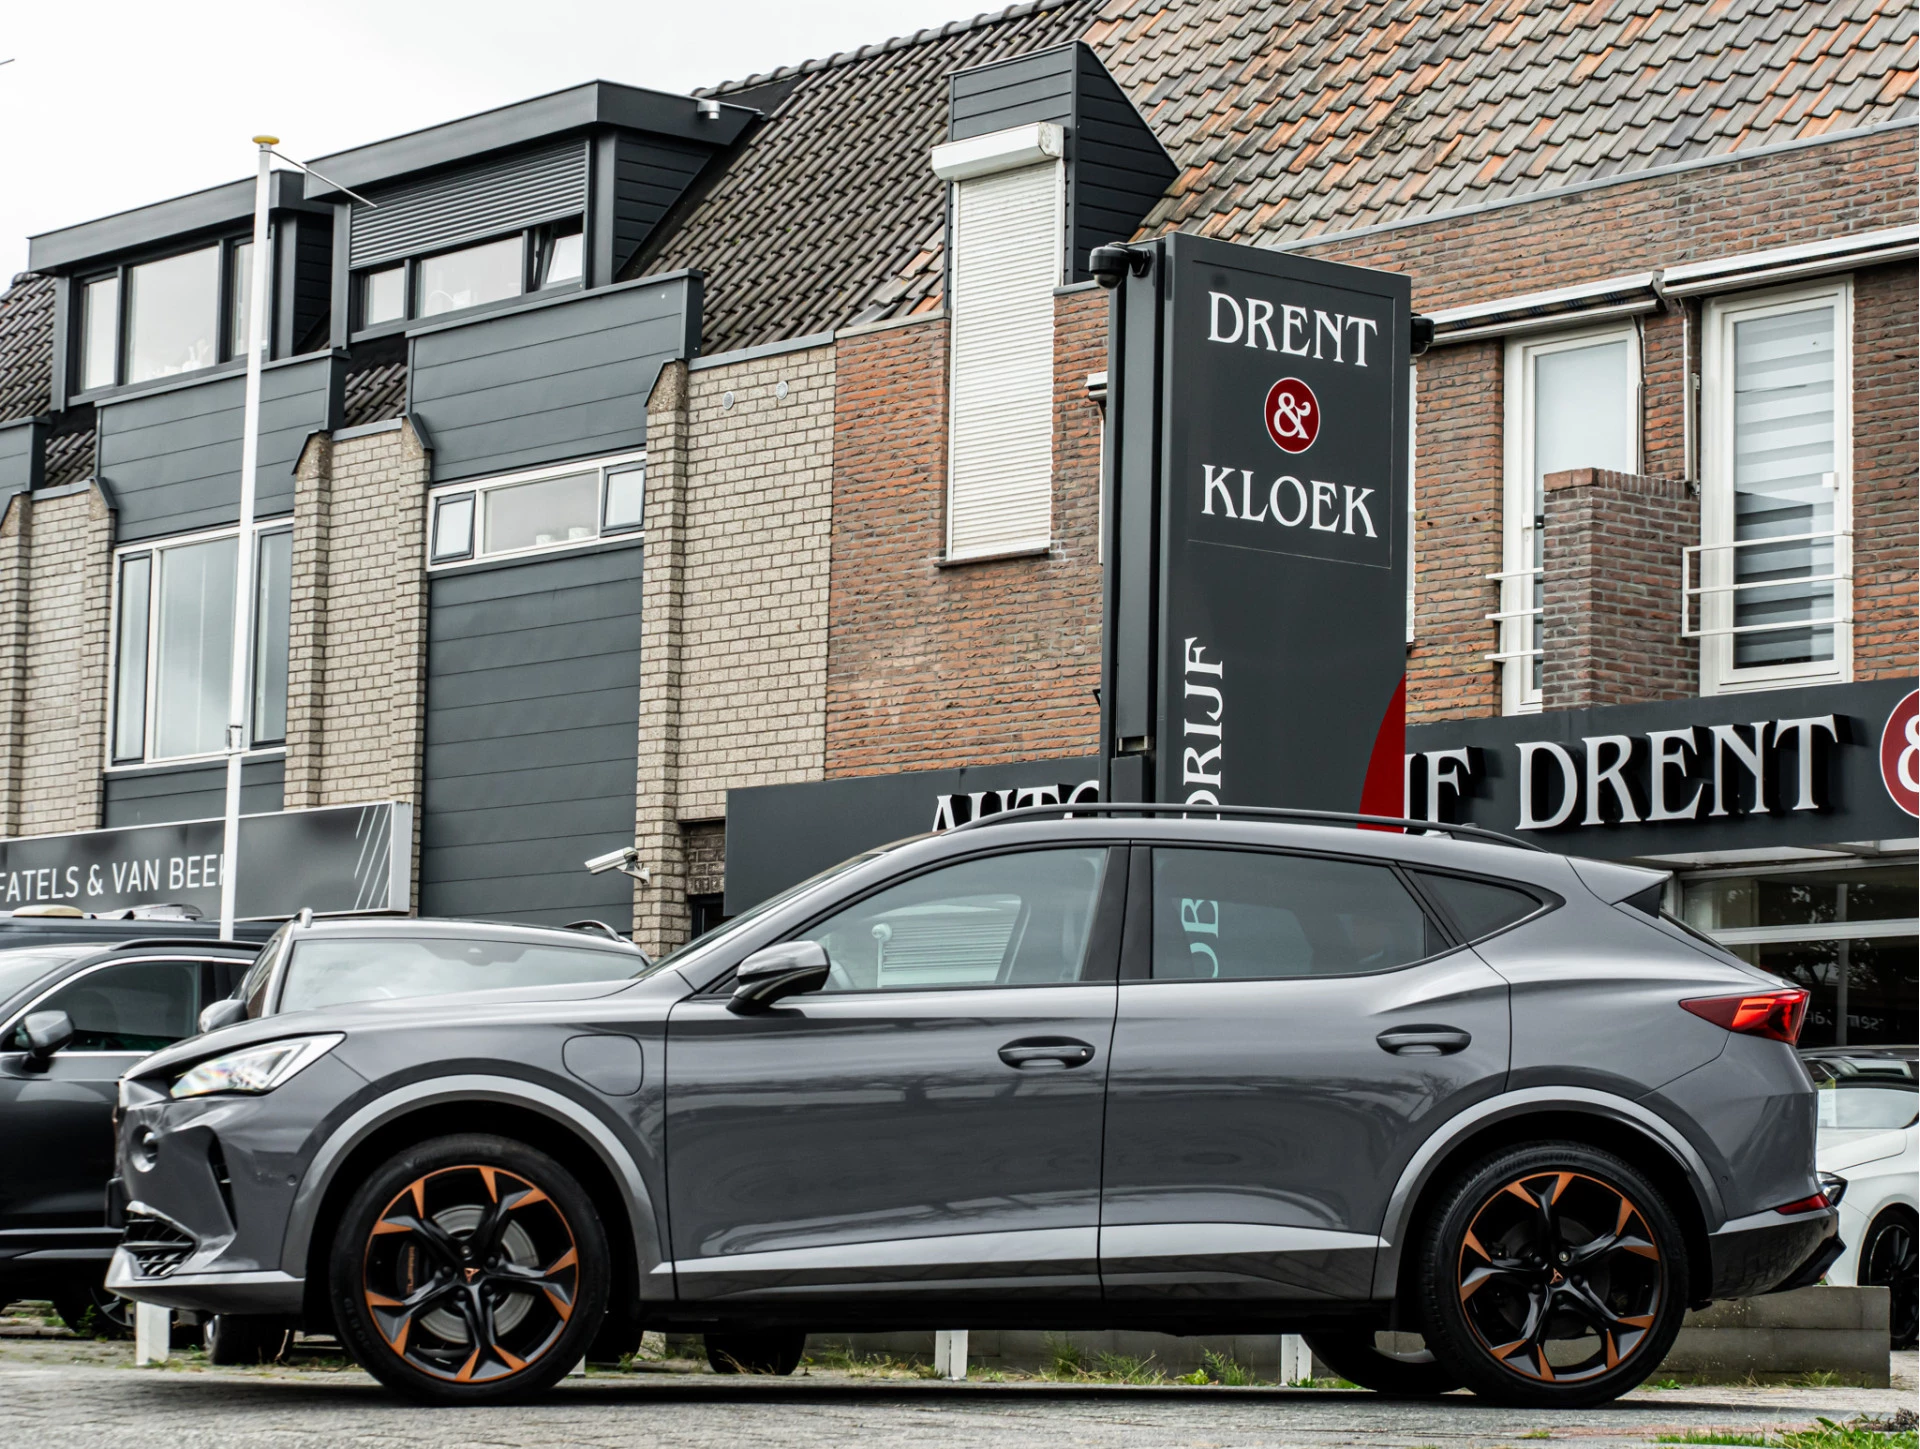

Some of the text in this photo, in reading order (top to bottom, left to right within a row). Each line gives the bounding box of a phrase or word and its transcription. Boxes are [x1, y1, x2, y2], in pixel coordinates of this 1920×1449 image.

[1207, 290, 1378, 367] DRENT
[1273, 392, 1311, 439] &
[1201, 463, 1378, 538] KLOEK
[1515, 713, 1839, 831] DRENT
[87, 864, 104, 896] &
[112, 858, 160, 894] VAN
